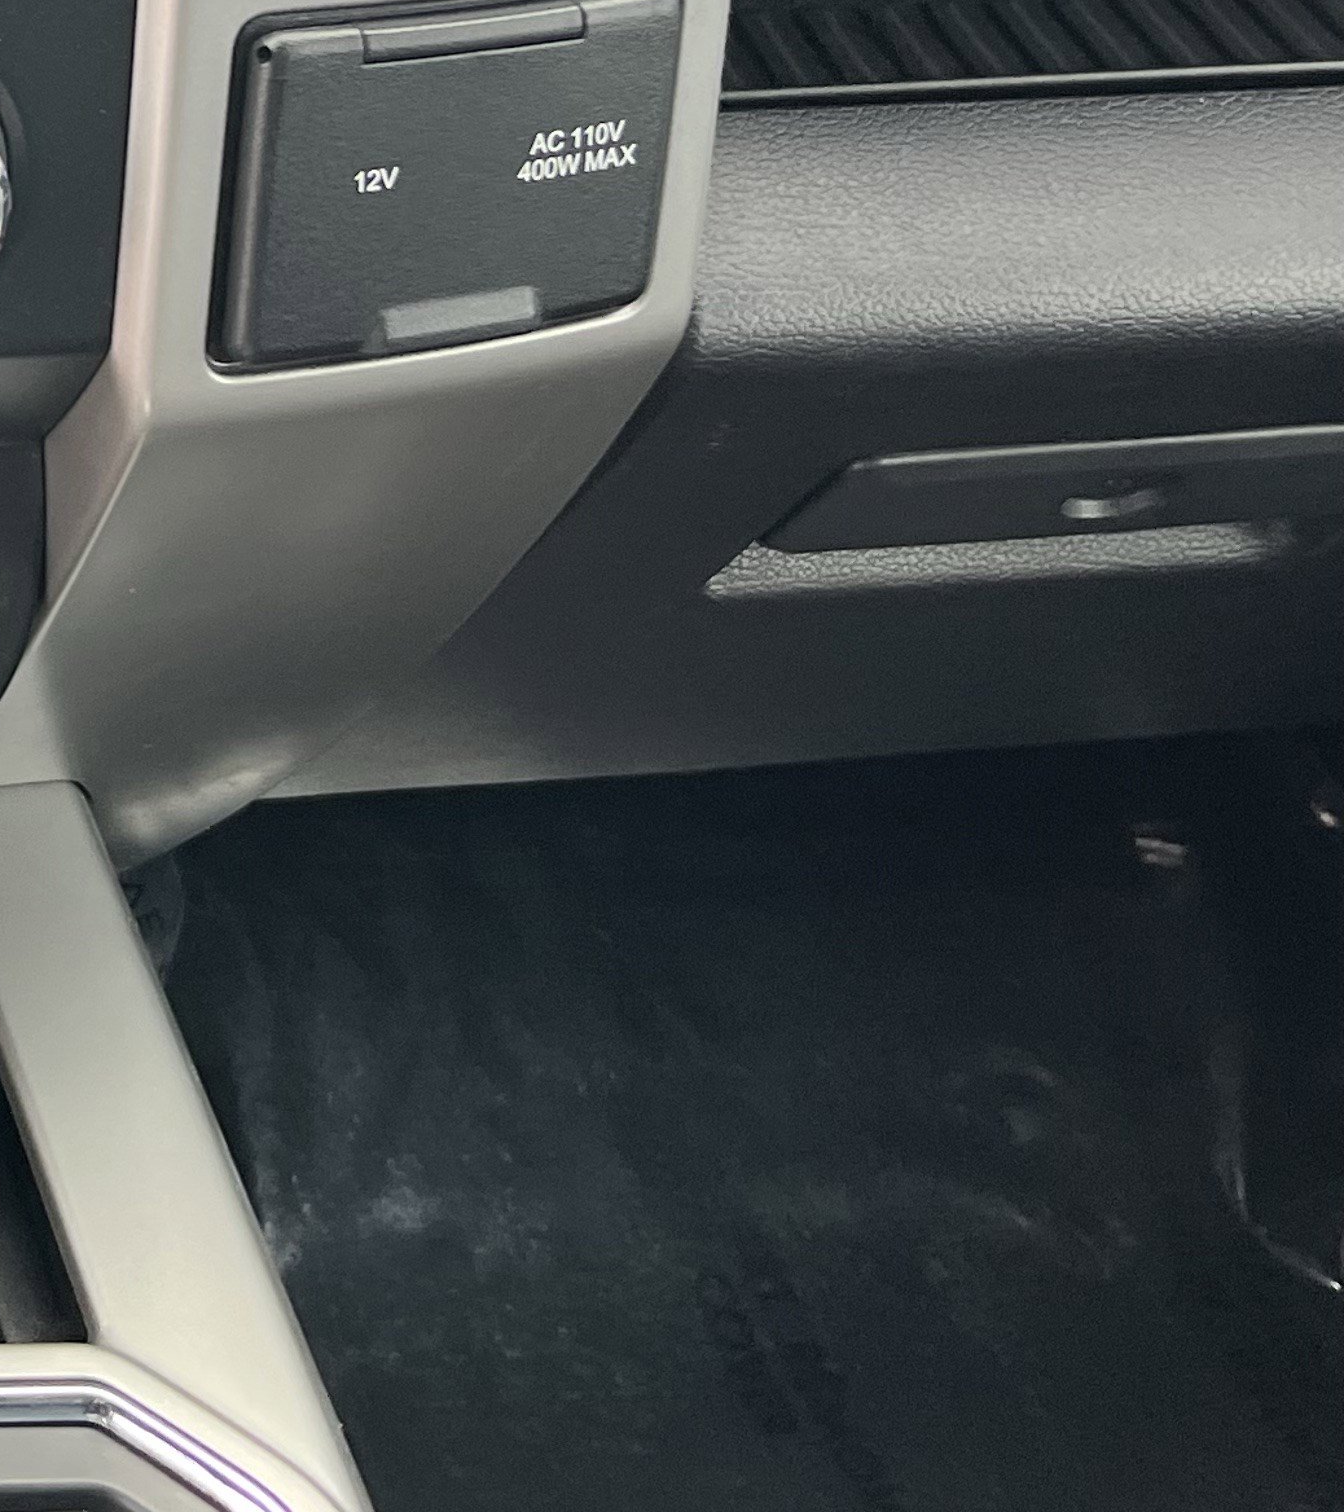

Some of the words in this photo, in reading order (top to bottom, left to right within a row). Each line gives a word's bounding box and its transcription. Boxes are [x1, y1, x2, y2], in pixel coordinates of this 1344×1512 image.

[529, 130, 566, 157] AC
[570, 119, 627, 149] 110V
[353, 166, 400, 194] 12V
[516, 154, 581, 183] 400W
[583, 143, 639, 175] MAX
